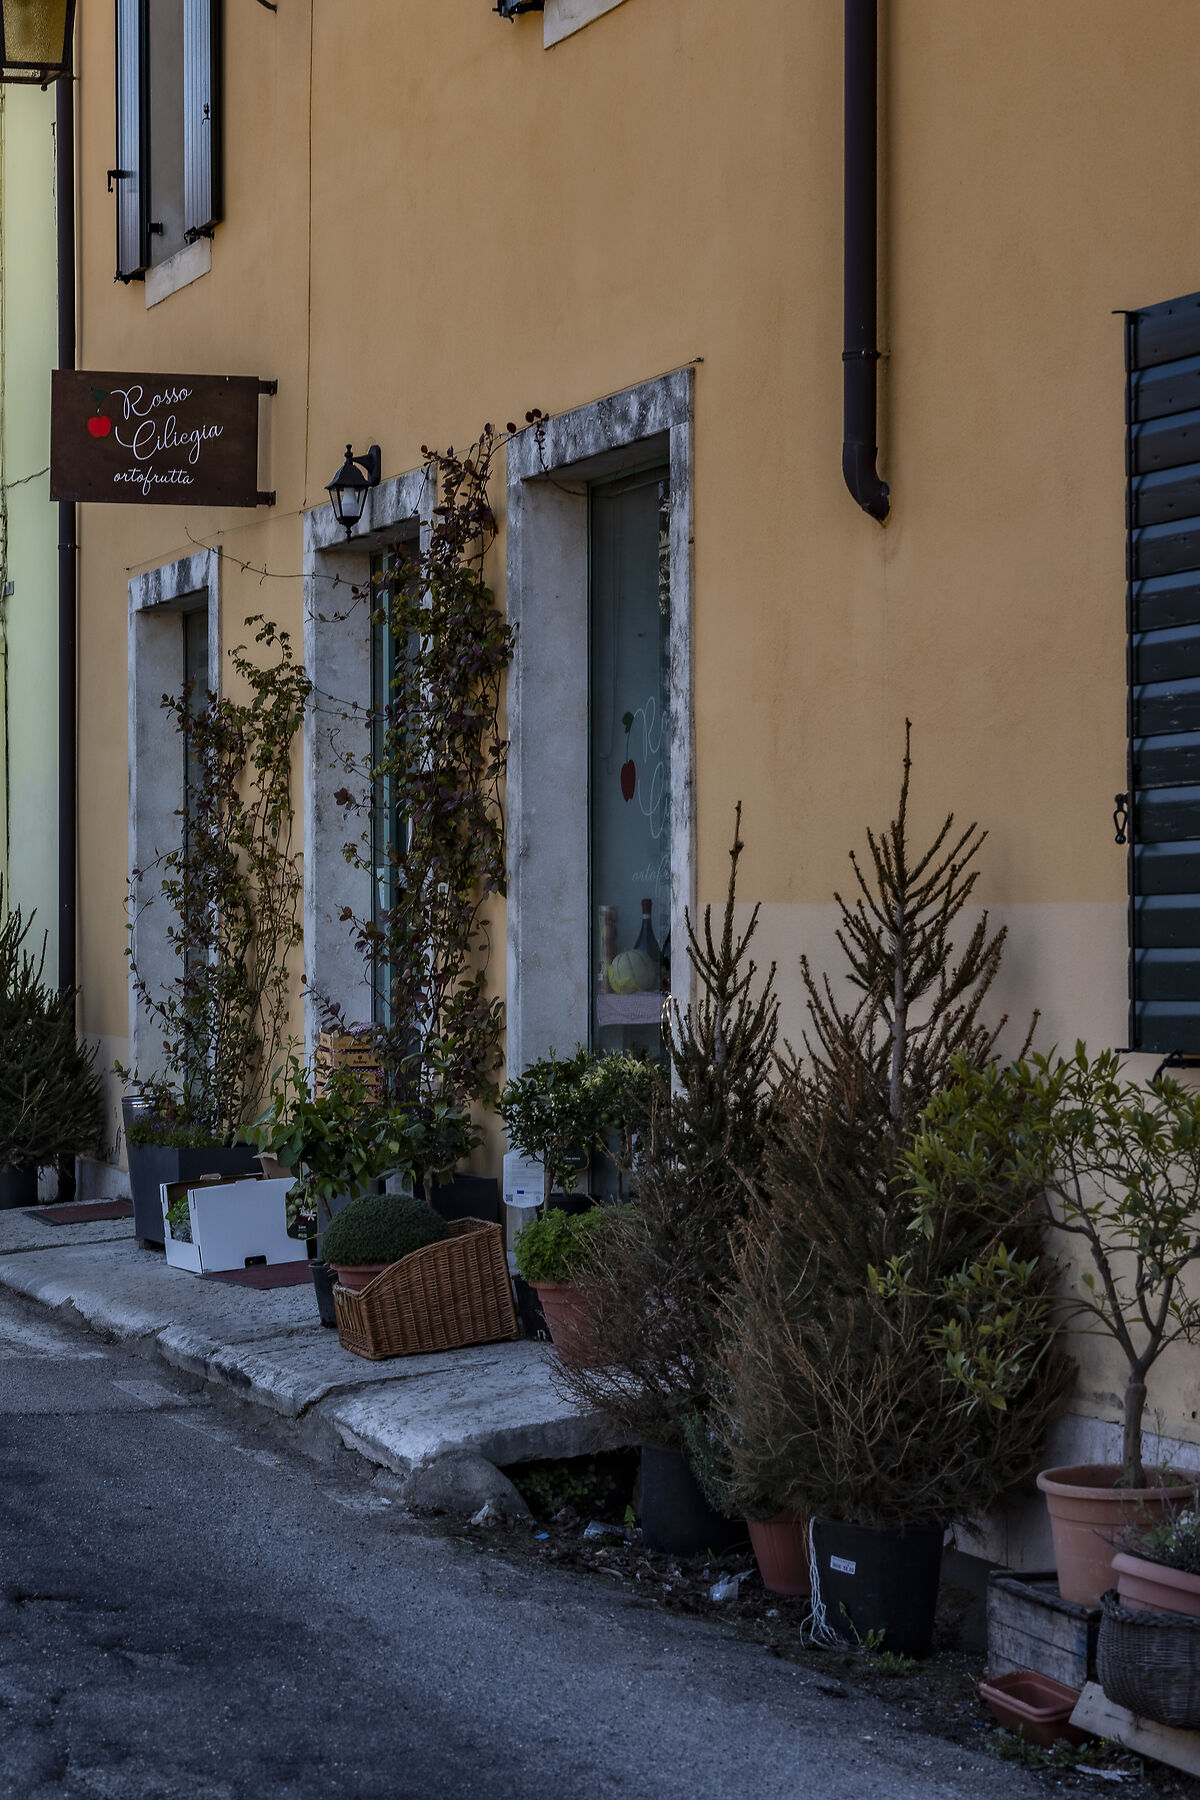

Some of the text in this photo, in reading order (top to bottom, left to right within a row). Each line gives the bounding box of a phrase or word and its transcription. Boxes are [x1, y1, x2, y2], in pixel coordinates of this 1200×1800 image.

[110, 385, 193, 420] Rosso
[115, 415, 224, 464] Ciliegia
[113, 466, 195, 496] ortofrutta
[634, 696, 671, 764] Ro
